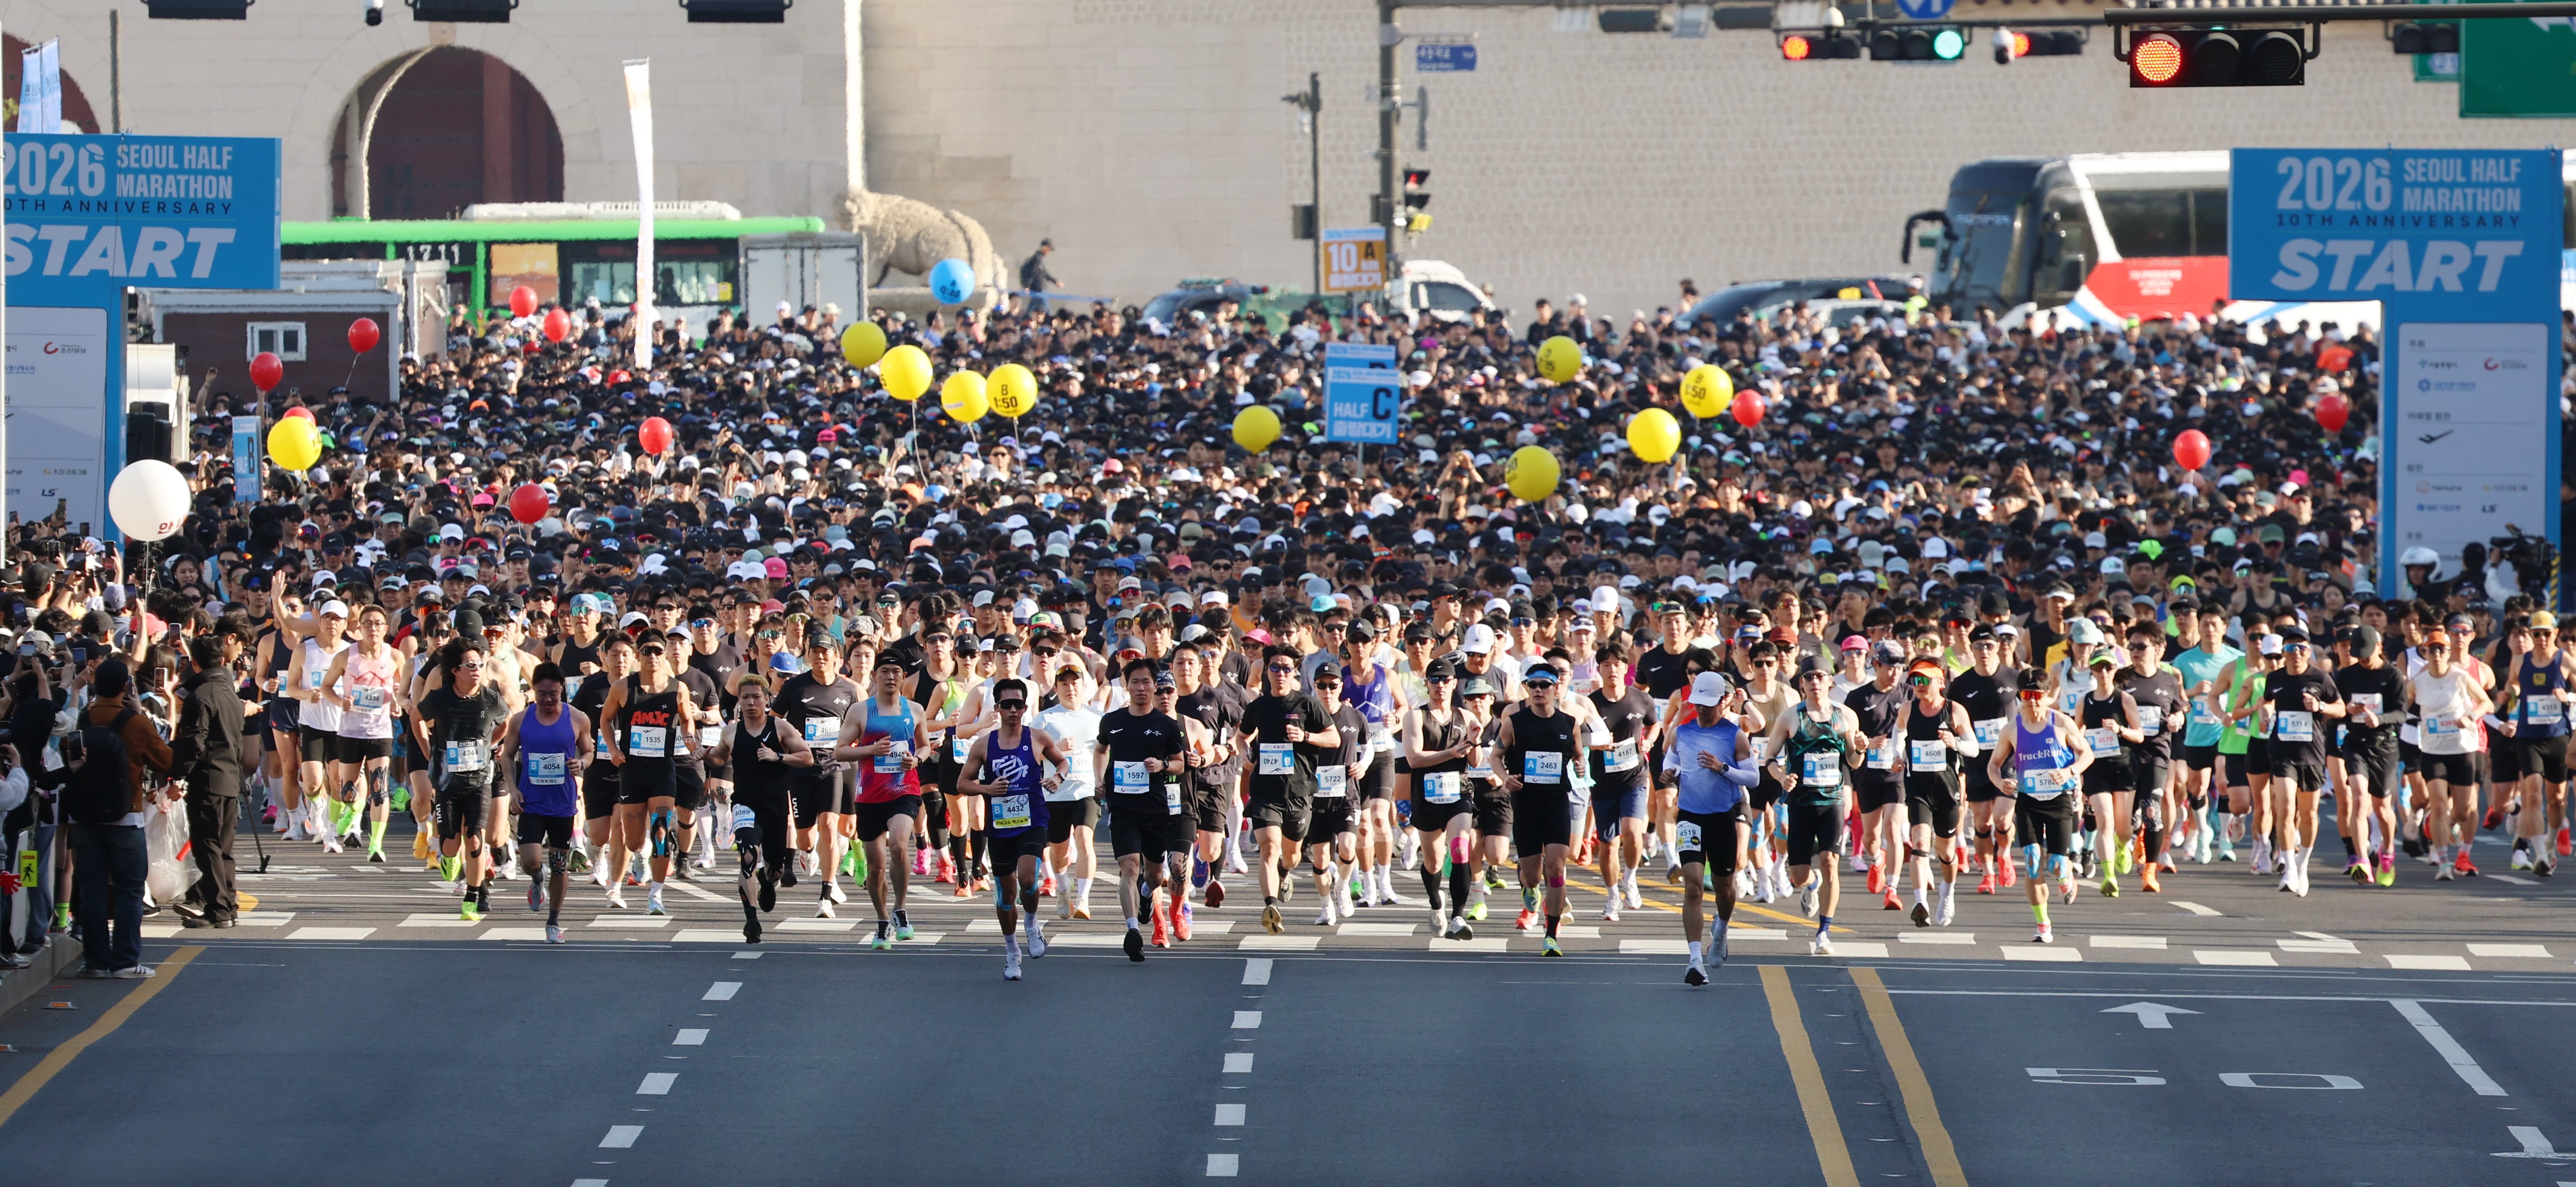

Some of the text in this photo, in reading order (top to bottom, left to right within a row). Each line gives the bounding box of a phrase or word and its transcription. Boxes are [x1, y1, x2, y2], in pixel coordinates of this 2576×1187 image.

[117, 145, 232, 169] SEOUL HALF
[2404, 158, 2522, 182] SEOUL HALF
[117, 174, 232, 199] MARATHON
[2277, 157, 2392, 210] 2026
[4, 199, 232, 214] 0TH ANNIVERSARY
[2403, 188, 2521, 212] MARATHON
[2277, 215, 2521, 227] 10TH ANNIVERSARY
[407, 244, 460, 265] 1711
[1328, 242, 1375, 272] 10 A
[1361, 260, 1379, 270] km
[2271, 238, 2525, 292] START
[1001, 384, 1008, 396] B
[994, 397, 1018, 408] 1:50
[1334, 388, 1392, 420] HALF C
[248, 436, 255, 474] B
[631, 711, 670, 726] AMJC
[1618, 748, 1632, 757] 4187
[2018, 749, 2062, 762] TrackRun
[1807, 762, 1813, 771] B
[2027, 778, 2034, 787] B
[994, 805, 1024, 814] B 4432
[2025, 1067, 2364, 1089] 50
